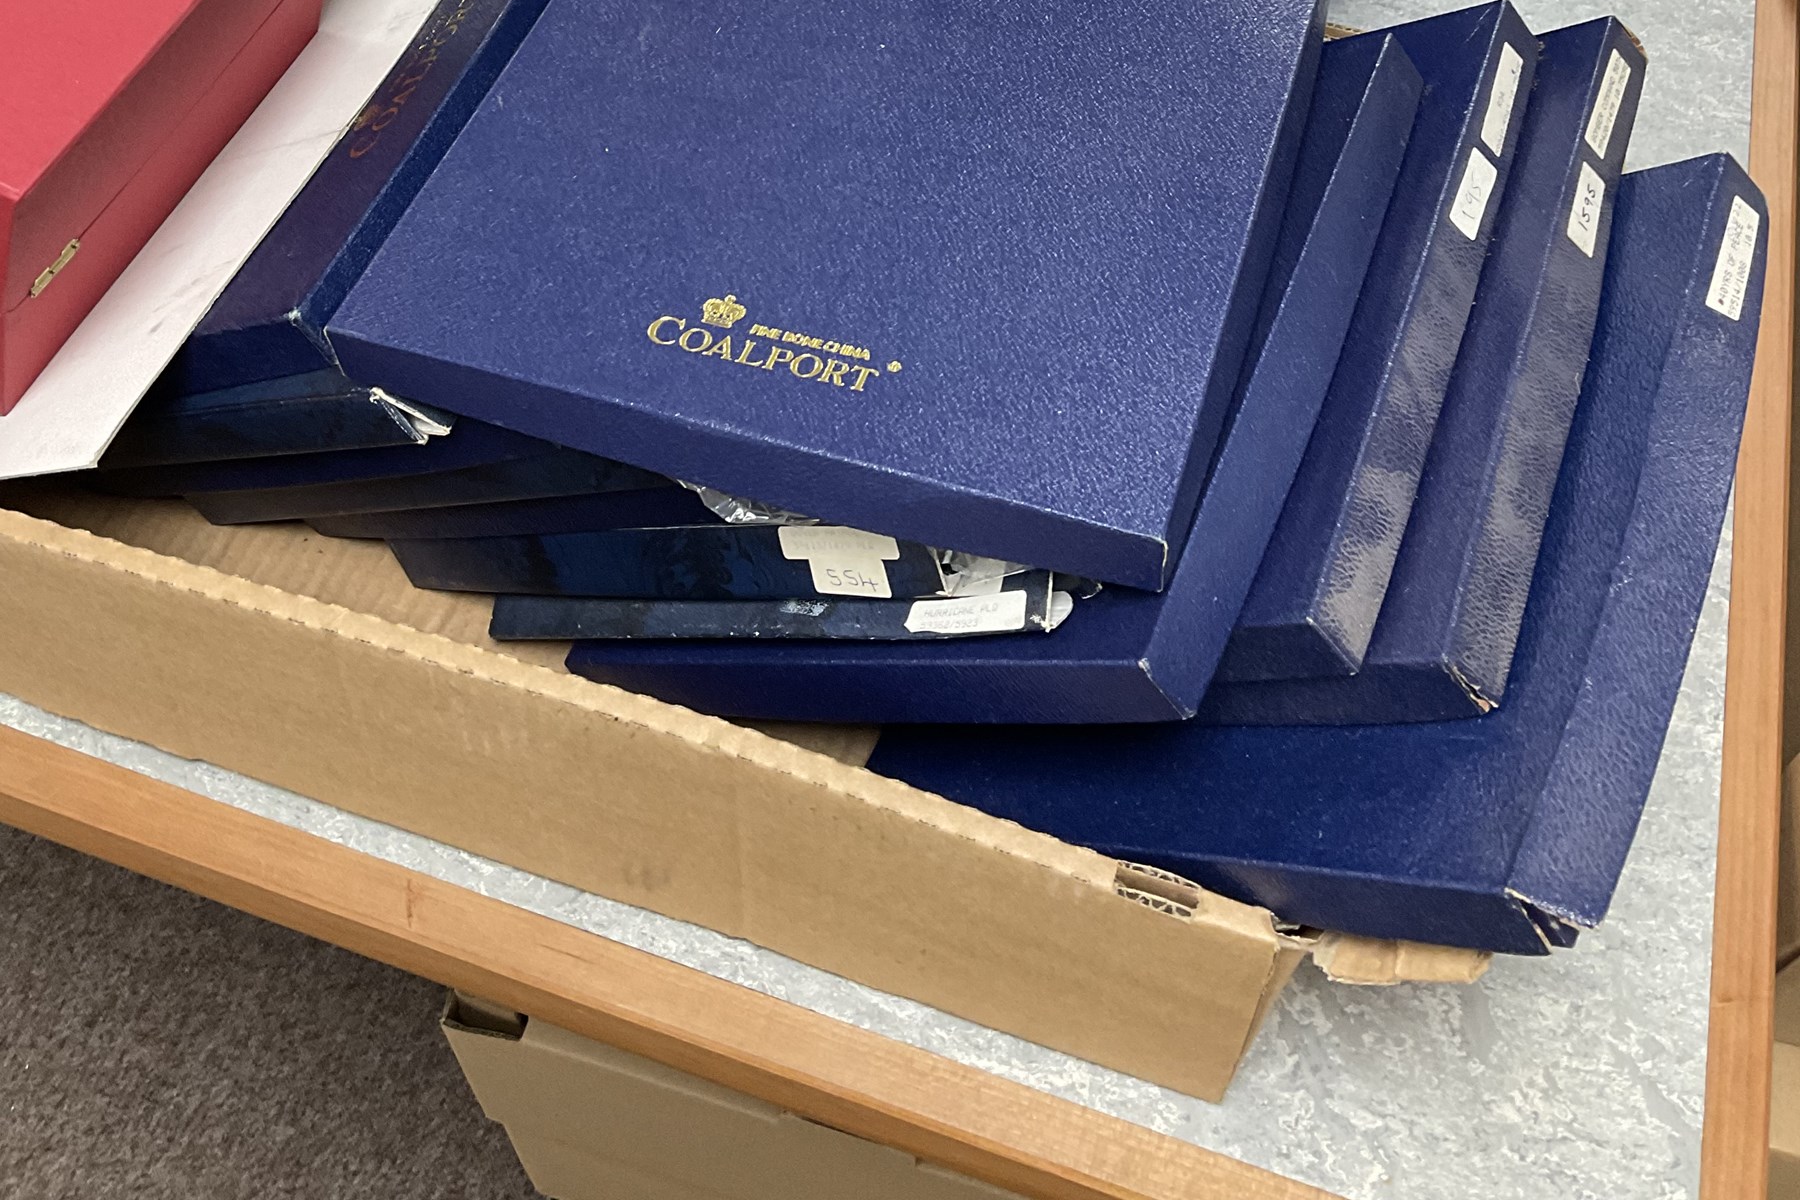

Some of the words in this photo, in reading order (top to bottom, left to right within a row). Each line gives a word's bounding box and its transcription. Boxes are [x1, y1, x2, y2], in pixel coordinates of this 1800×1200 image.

[1578, 183, 1596, 231] 1595
[1727, 253, 1736, 267] OF
[647, 315, 880, 392] COALPORT
[750, 323, 782, 341] FINE
[782, 330, 823, 350] BONE
[822, 340, 871, 361] CHINA
[826, 568, 879, 593] 554
